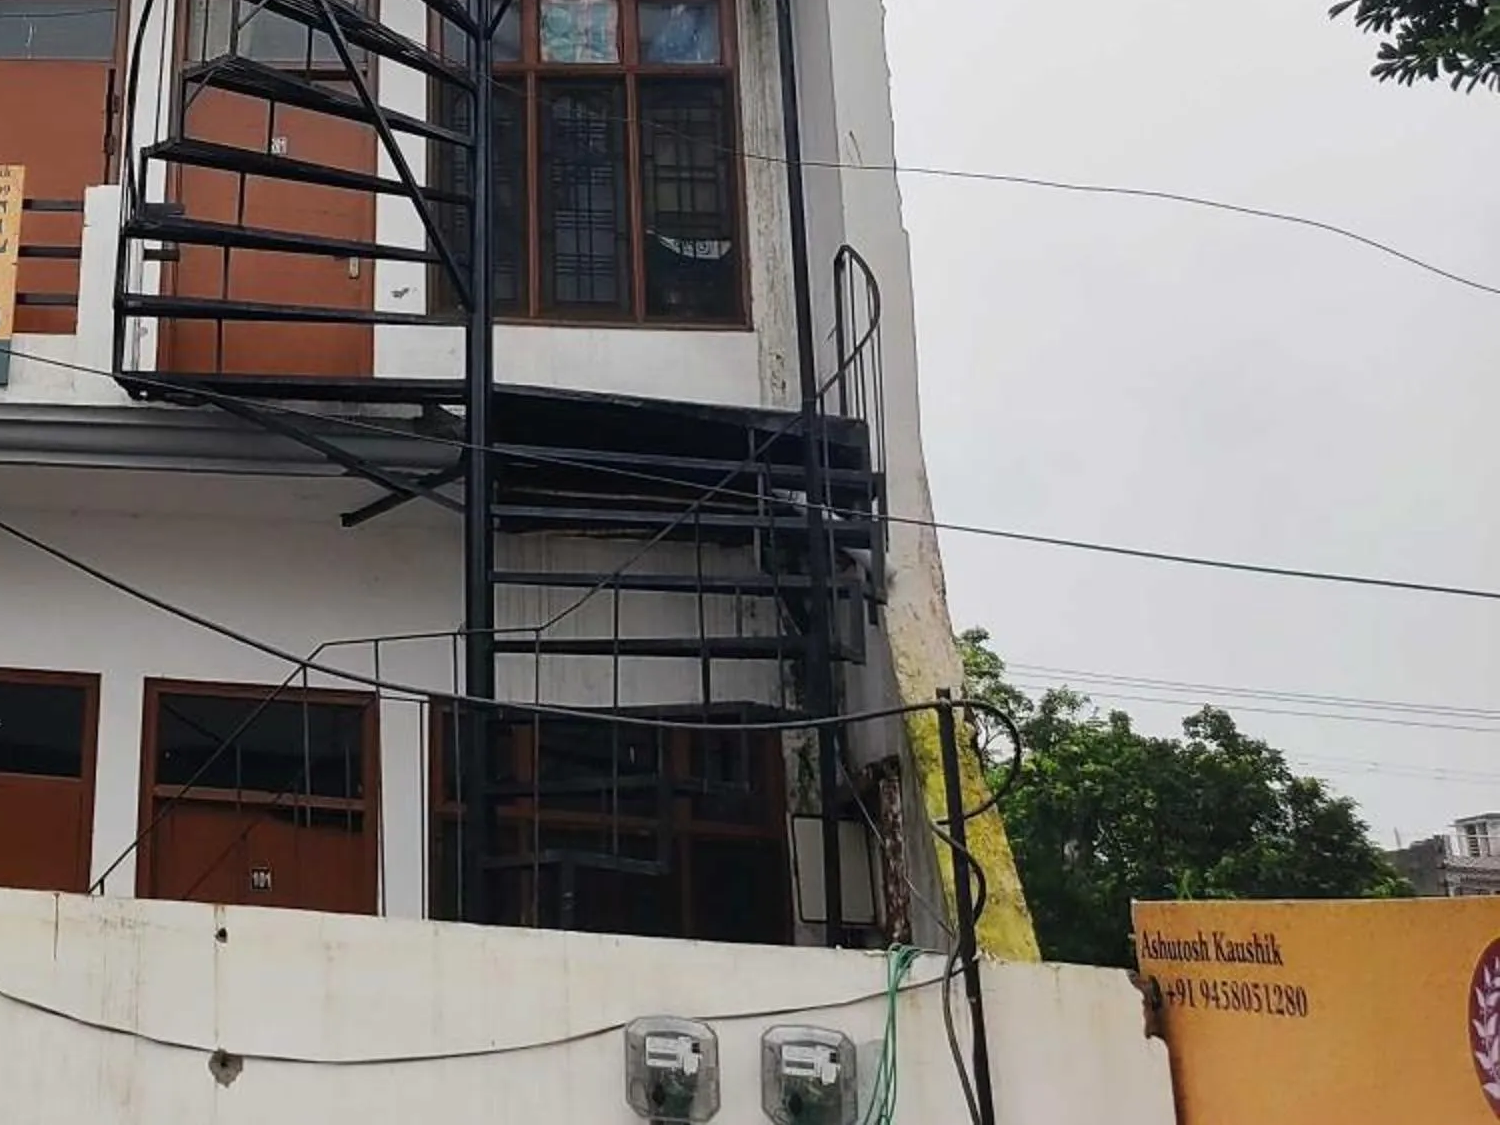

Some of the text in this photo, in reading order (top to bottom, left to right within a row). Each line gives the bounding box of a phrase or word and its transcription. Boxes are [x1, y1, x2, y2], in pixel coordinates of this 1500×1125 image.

[1141, 931, 1284, 967] Ashutosh Kaushik
[1166, 978, 1308, 1018] +91 9458051280
